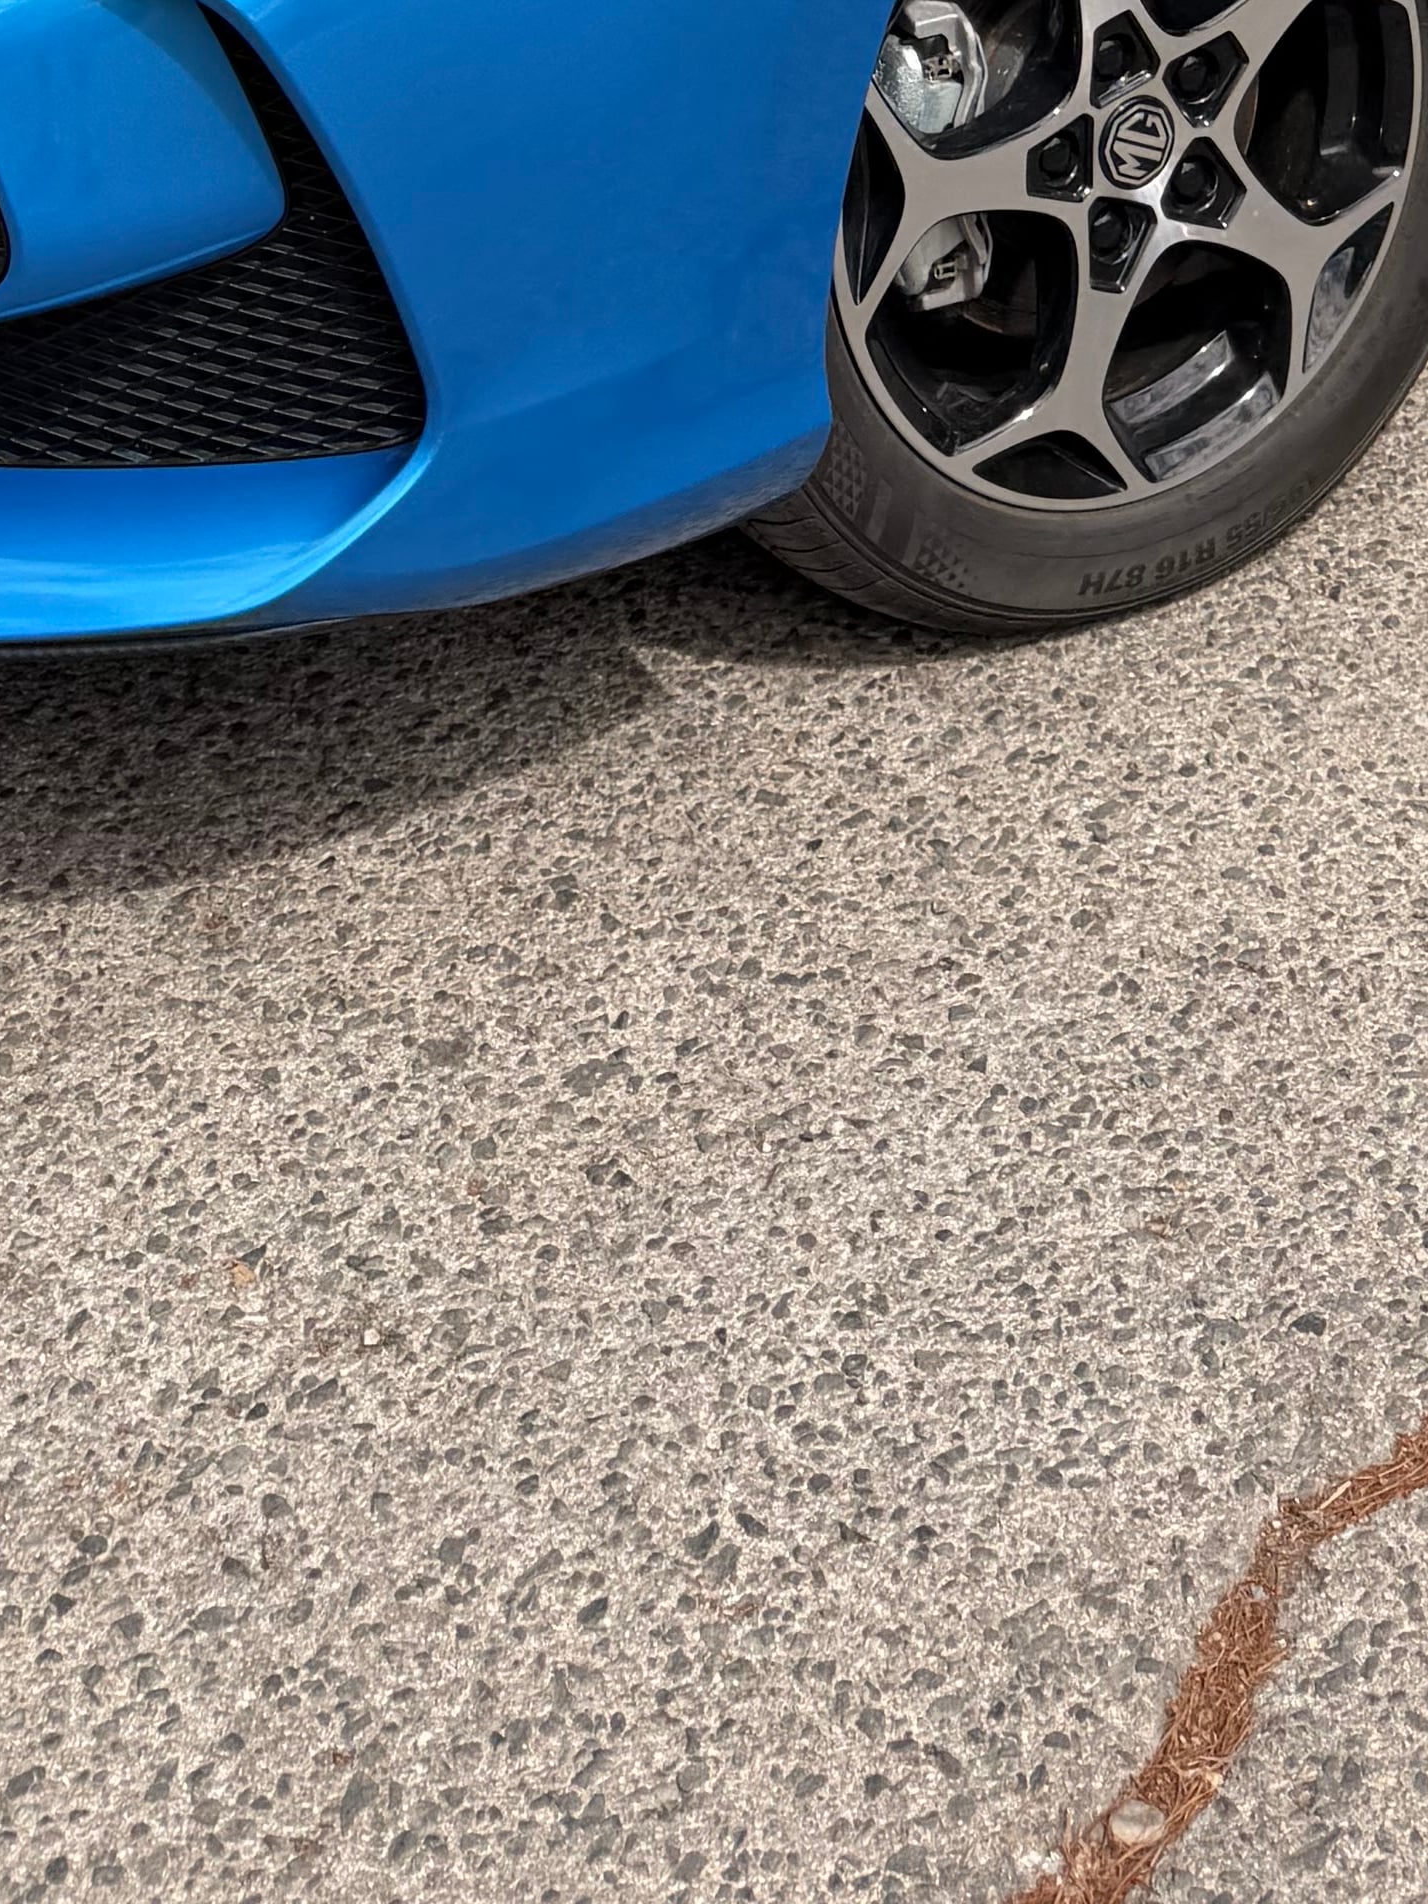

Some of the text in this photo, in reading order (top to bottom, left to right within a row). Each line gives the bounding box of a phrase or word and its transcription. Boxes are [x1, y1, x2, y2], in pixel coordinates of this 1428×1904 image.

[1112, 111, 1168, 179] MG
[1078, 563, 1147, 596] 87H
[1154, 537, 1216, 580] R16
